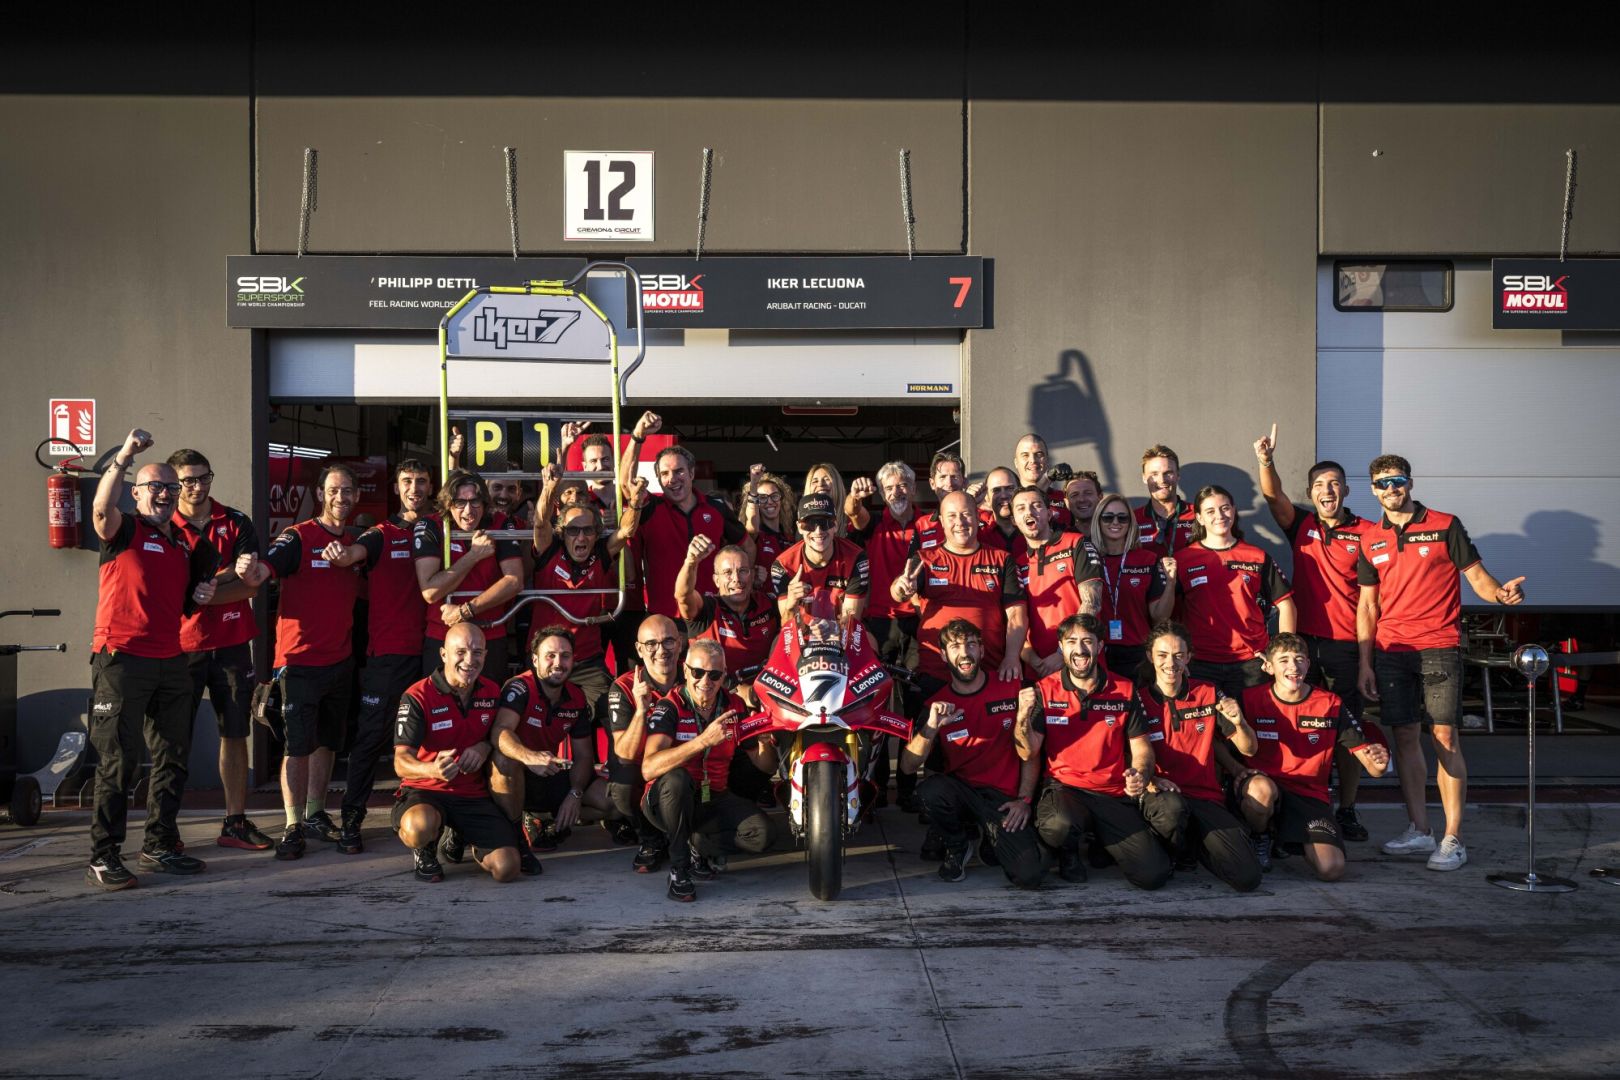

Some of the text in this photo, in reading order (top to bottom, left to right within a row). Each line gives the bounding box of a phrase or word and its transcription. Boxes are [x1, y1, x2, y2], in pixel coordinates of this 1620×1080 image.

[583, 160, 636, 221] 12
[237, 276, 304, 292] SBK
[378, 278, 480, 288] PHILIPP OETTL
[640, 274, 702, 290] SBK
[768, 278, 864, 288] IKER LECUONA
[1503, 275, 1567, 291] SBK
[237, 294, 304, 302] SUPERSPORT
[642, 294, 700, 306] MOTUL
[949, 276, 972, 308] 7
[1506, 294, 1564, 308] MOTUL
[475, 421, 550, 467] P 1
[1408, 532, 1439, 542] aruba.it
[1122, 566, 1150, 574] aruba.it
[1230, 564, 1260, 572] aruba.it
[798, 656, 849, 676] aruba.it
[768, 666, 798, 685] ALTEN
[848, 664, 877, 685] ALTEN
[762, 672, 792, 694] Lenovo
[806, 676, 840, 702] 7
[852, 672, 884, 694] Lenovo
[1093, 702, 1124, 710] aruba.it
[1302, 720, 1332, 728] aruba.it
